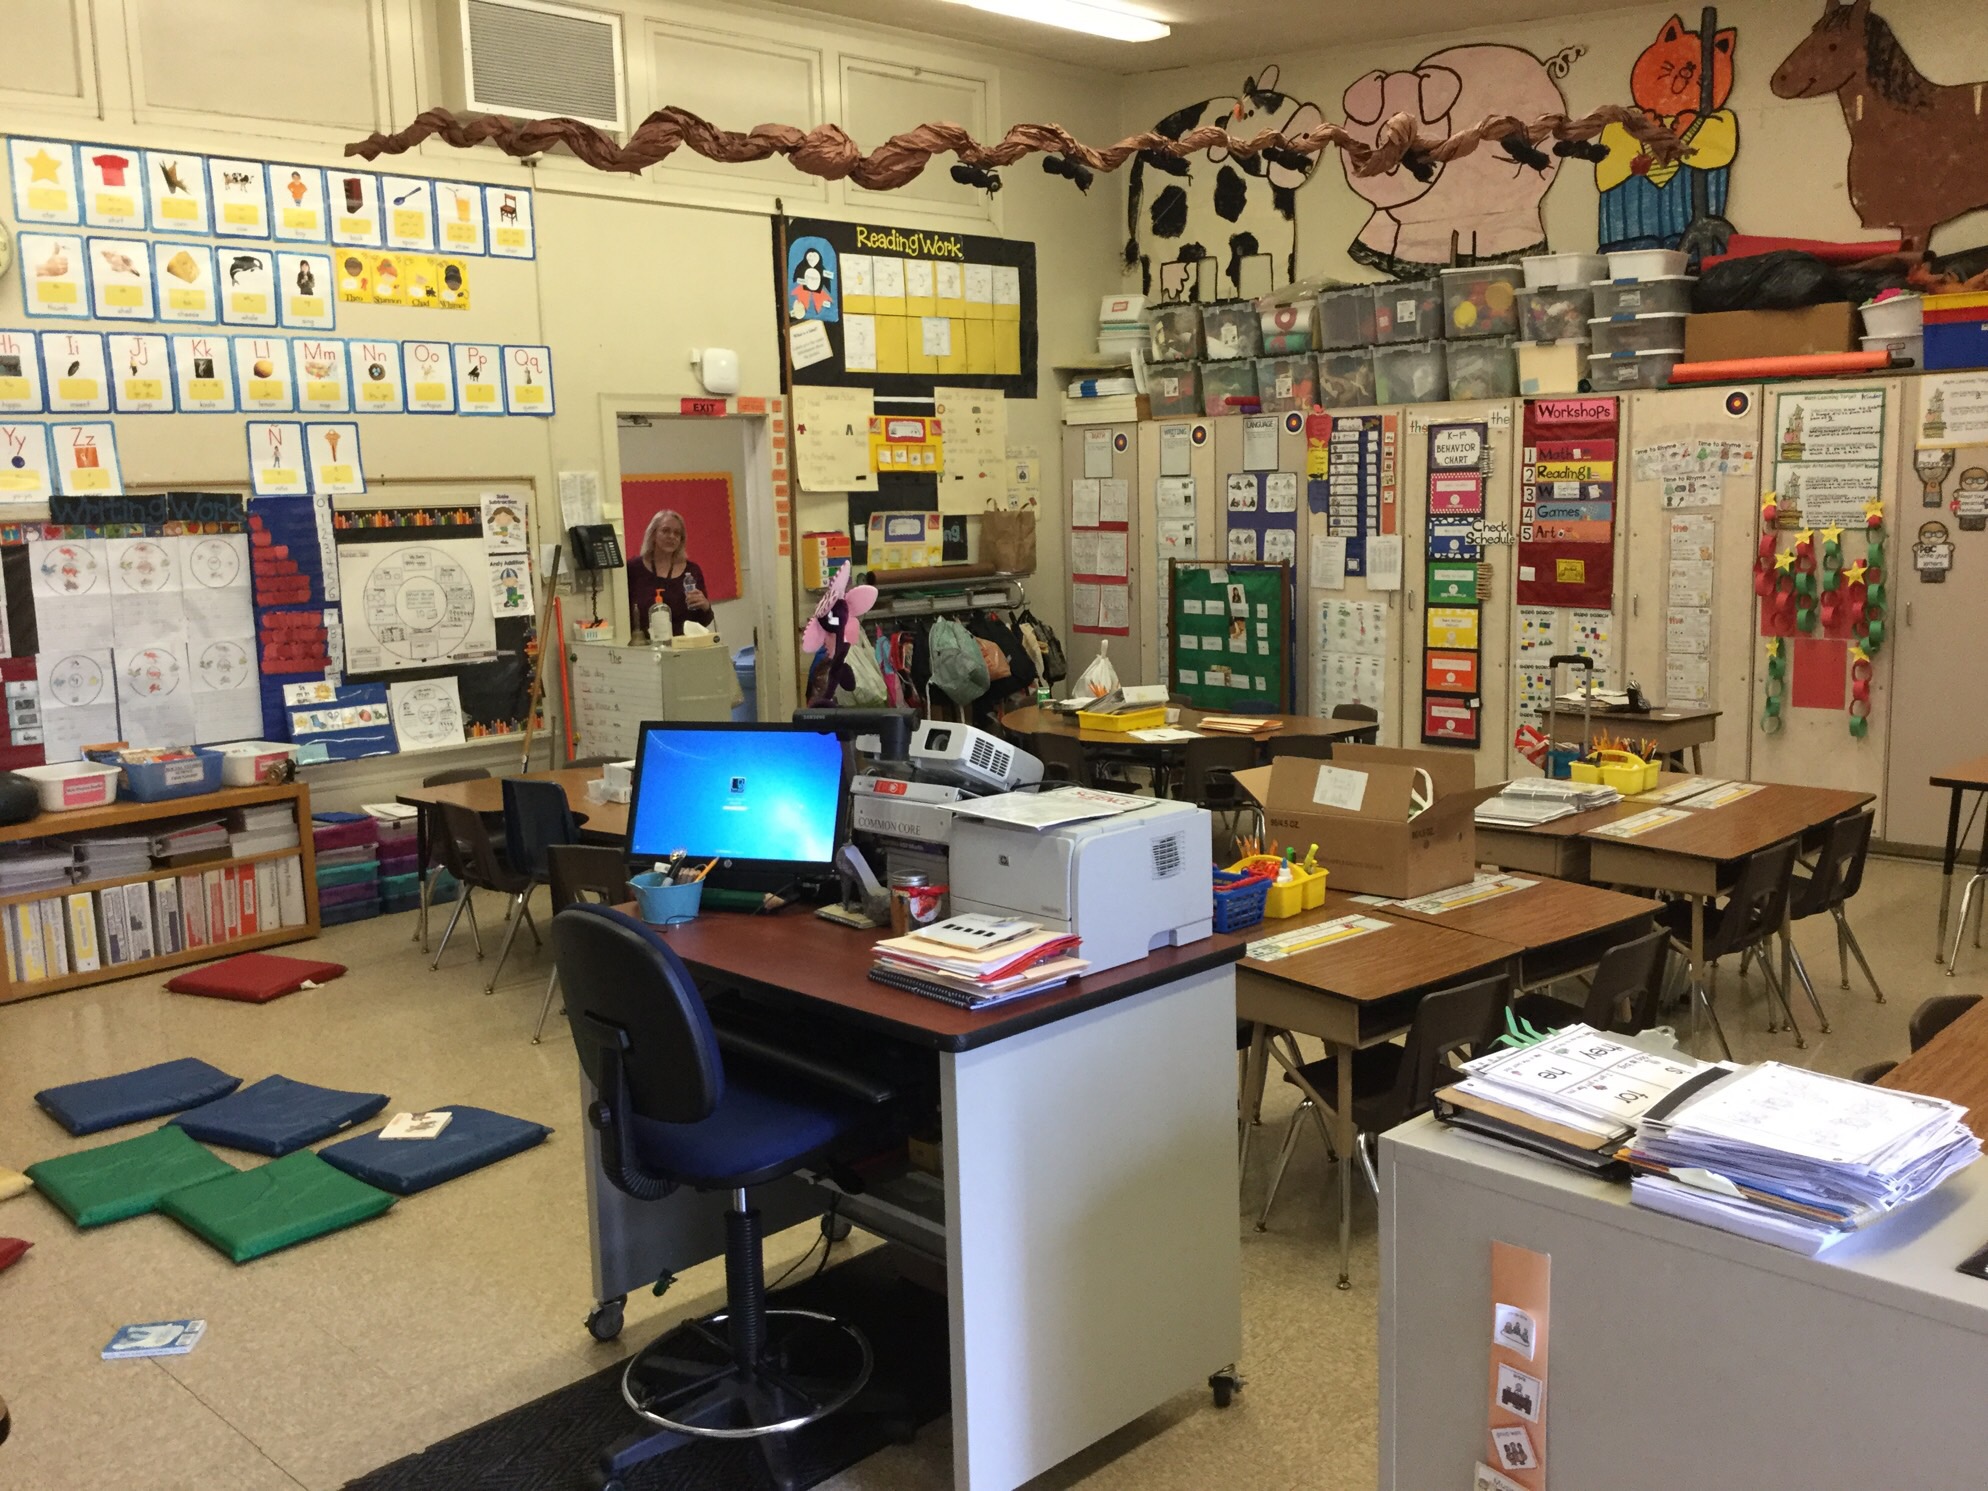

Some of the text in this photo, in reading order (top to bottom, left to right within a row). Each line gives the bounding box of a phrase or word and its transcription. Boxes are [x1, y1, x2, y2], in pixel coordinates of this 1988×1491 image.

[108, 217, 124, 225] shirt
[857, 227, 964, 258] Reading Work
[344, 294, 363, 302] Theo
[374, 296, 402, 305] Shannon
[412, 298, 430, 308] Chad
[48, 304, 68, 312] thumb
[66, 336, 80, 356] Ii
[130, 338, 148, 366] Jj
[192, 340, 213, 358] Kk
[254, 340, 270, 358] Ll
[304, 342, 336, 360] Mm
[363, 344, 387, 362] Nn
[414, 344, 440, 362] Oo
[468, 347, 488, 371] Pp
[514, 350, 542, 374] Qq
[693, 402, 716, 414] EXIT
[1538, 402, 1611, 418] Workshops
[1246, 420, 1274, 428] LANGUAGE
[1490, 412, 1510, 424] the
[2, 427, 26, 456] Yy
[71, 428, 96, 446] Zz
[1436, 444, 1476, 453] BEHAVIOR
[1540, 450, 1574, 460] Math
[1444, 456, 1468, 464] CHART
[1526, 468, 1534, 482] 2
[1538, 466, 1586, 481] Reading
[1526, 488, 1534, 501] 3
[316, 498, 326, 508] 0
[53, 496, 243, 524] Writing Work
[1524, 508, 1533, 521] 4
[1537, 504, 1580, 518] Games
[1472, 519, 1508, 533] Check
[1536, 526, 1556, 538] Art
[322, 528, 328, 539] 2
[1466, 532, 1515, 544] Schedule
[1522, 528, 1532, 540] 5
[323, 544, 332, 554] 3
[327, 612, 335, 621] 7
[608, 651, 622, 664] the
[858, 817, 921, 836] COMMON CORE
[1538, 1066, 1572, 1080] he
[1614, 1089, 1649, 1104] for
